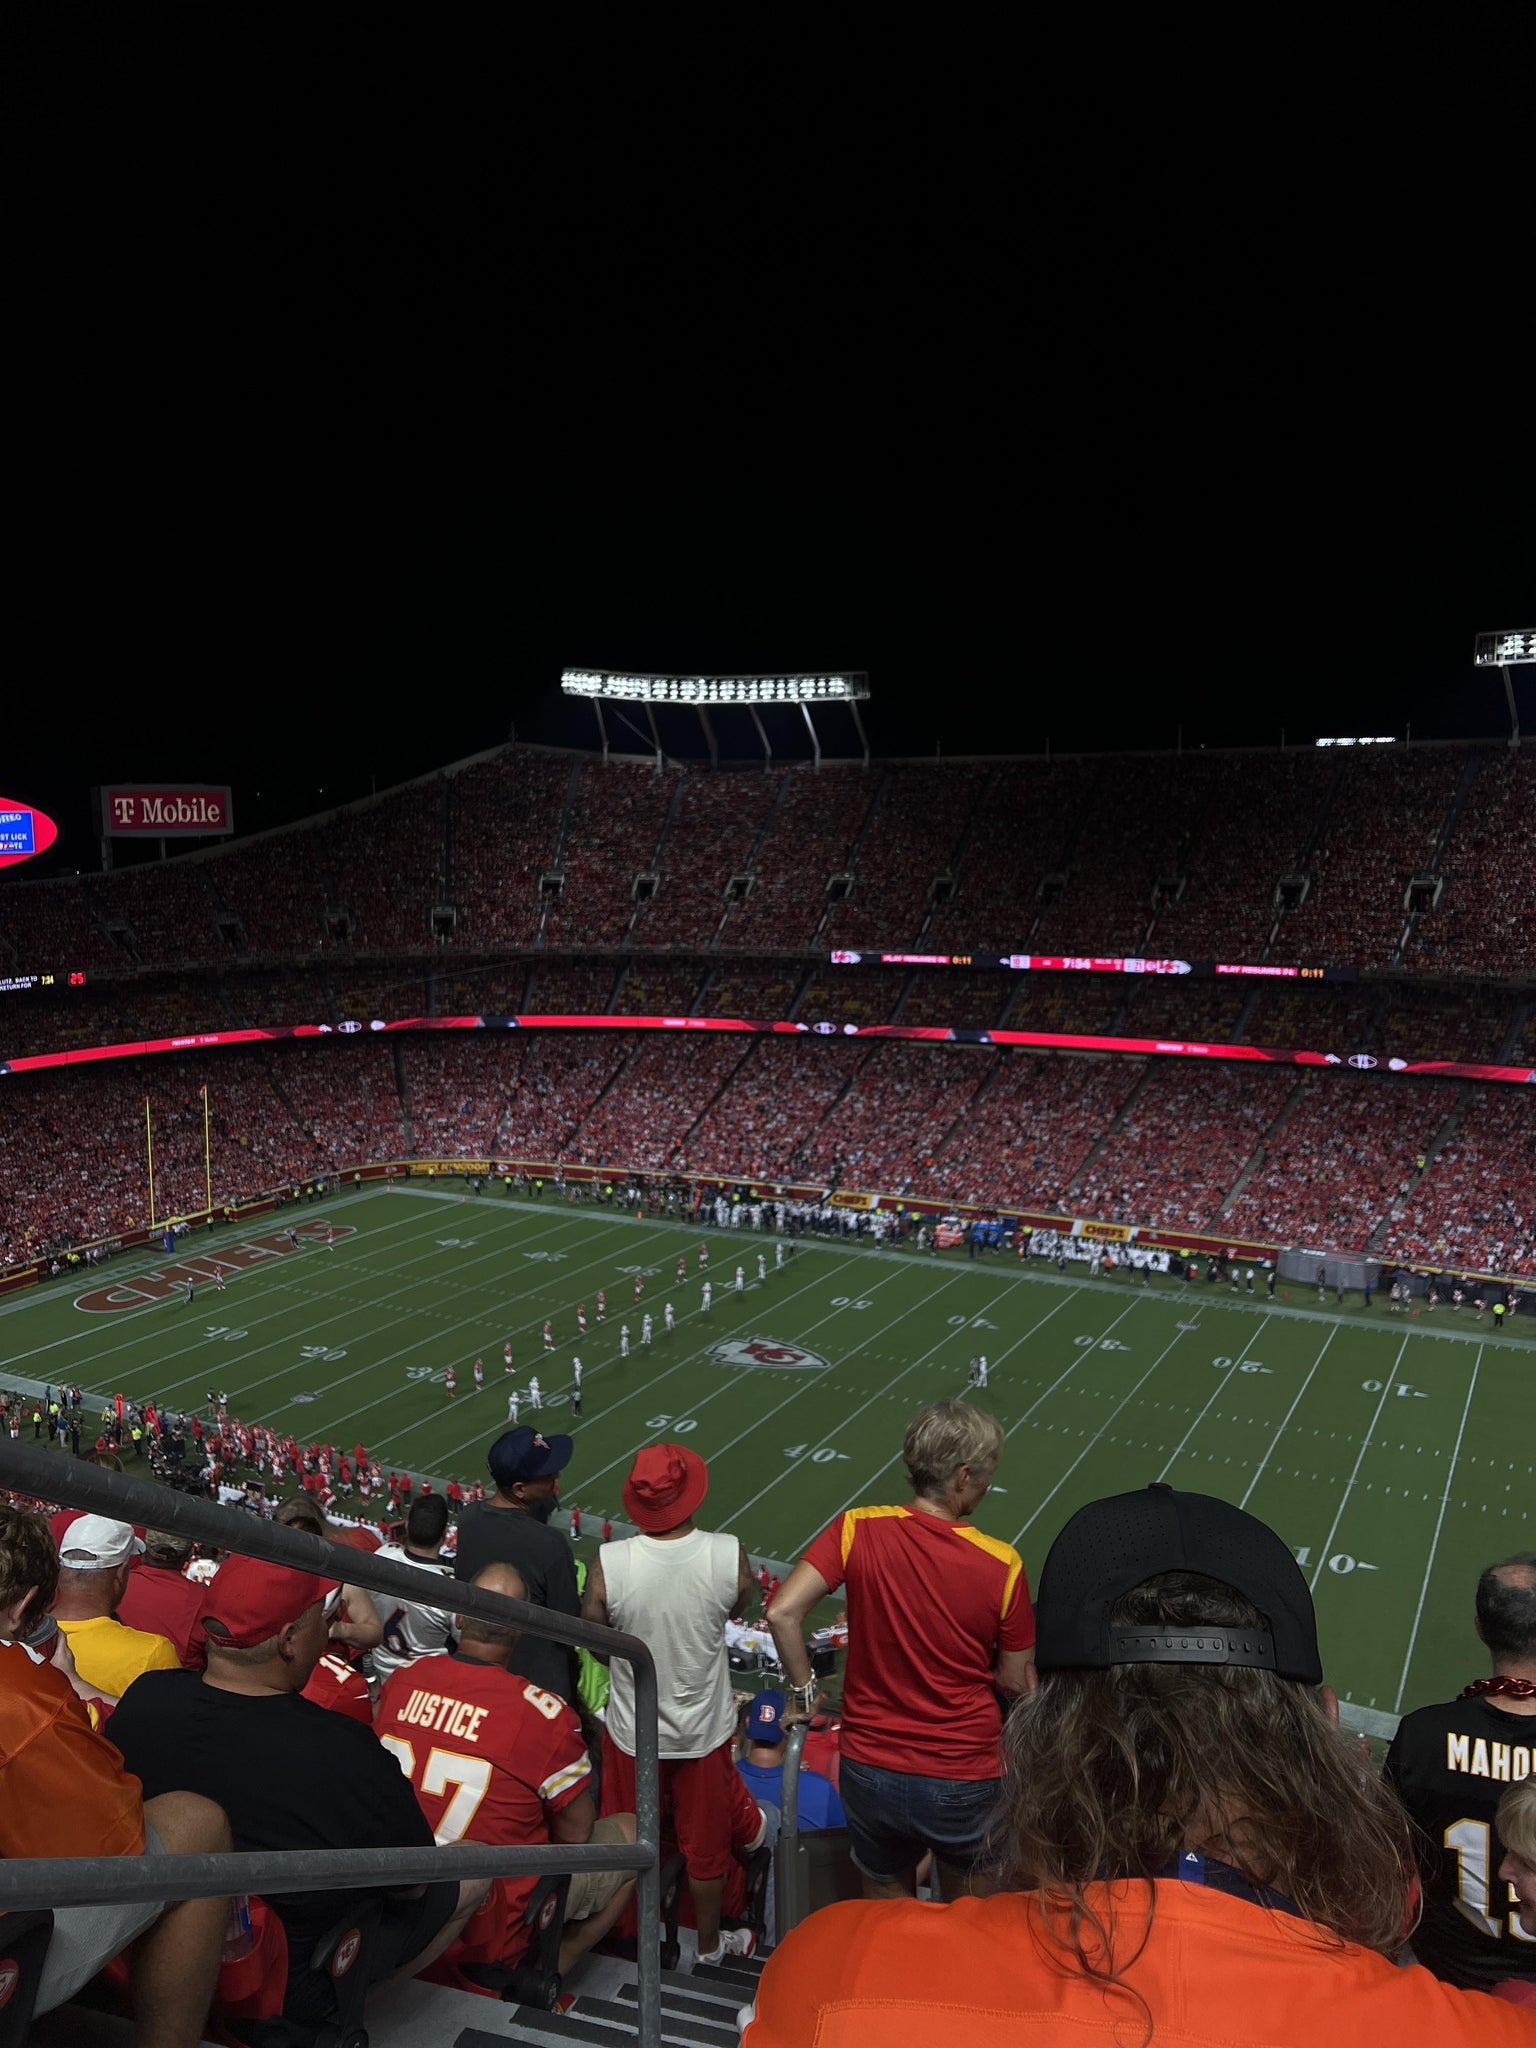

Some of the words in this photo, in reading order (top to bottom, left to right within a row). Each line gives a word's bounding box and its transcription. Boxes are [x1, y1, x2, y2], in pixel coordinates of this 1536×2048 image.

[141, 798, 220, 823] Mobile
[11, 833, 28, 841] LICK
[952, 956, 972, 965] 0:11
[1301, 968, 1324, 978] 0:11
[830, 1296, 874, 1310] 50
[1362, 1379, 1416, 1398] 10
[645, 1414, 698, 1433] 50
[783, 1443, 838, 1463] 40
[1293, 1546, 1357, 1575] 10
[396, 1688, 490, 1744] JUSTICE
[759, 1704, 776, 1722] D
[1445, 1731, 1536, 1783] MAHO
